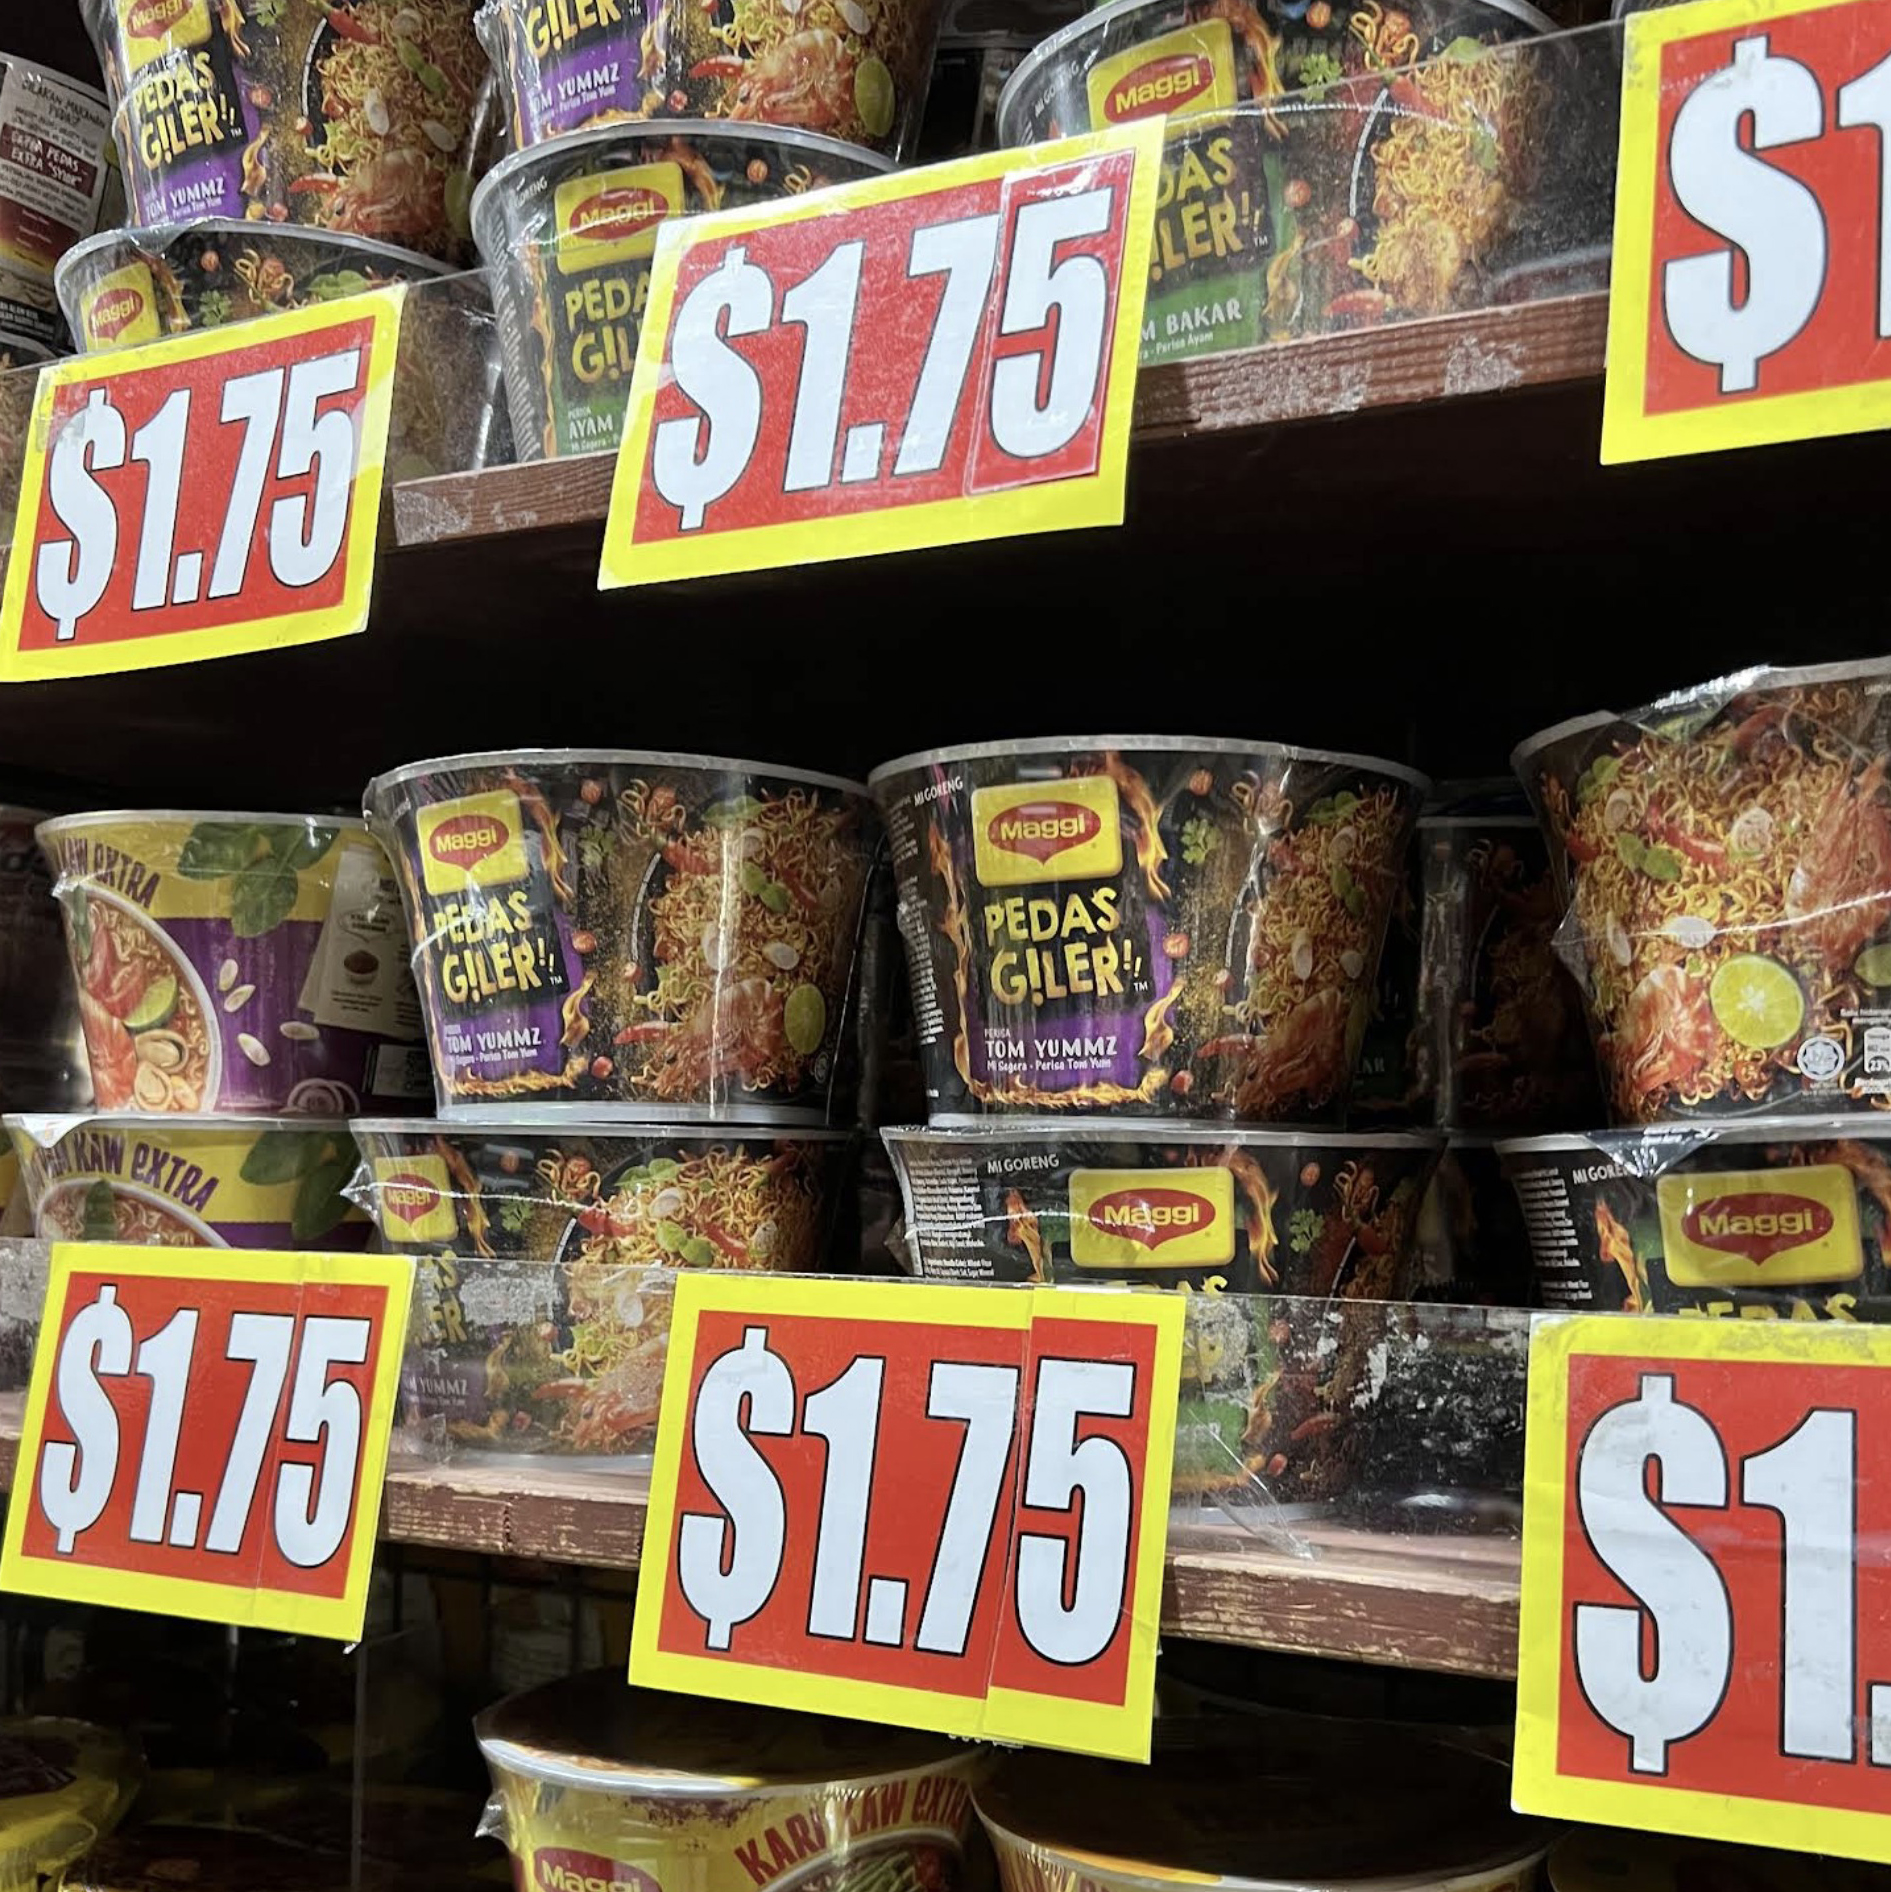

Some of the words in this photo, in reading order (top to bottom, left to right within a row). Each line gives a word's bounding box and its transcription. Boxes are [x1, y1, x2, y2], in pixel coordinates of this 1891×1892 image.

[132, 52, 216, 123] PEDAS
[557, 62, 620, 100] YUMMZ
[1115, 60, 1201, 115] Maggi
[1155, 137, 1238, 210] DAS
[169, 176, 226, 209] YUMMZ
[579, 197, 656, 227] Maggi
[565, 270, 652, 333] PEDA
[1166, 298, 1244, 336] BAKAR
[651, 186, 1113, 532] $1.75
[569, 413, 614, 440] AYAM
[35, 348, 361, 642] $1.75
[924, 775, 964, 804] GORENG
[435, 825, 498, 854] Maggi
[1000, 813, 1086, 842] Maggi
[433, 890, 533, 951] PEDAS
[984, 886, 1121, 947] PEDAS
[476, 1026, 542, 1052] YUMMZ
[984, 1039, 1026, 1059] TOM
[1033, 1036, 1118, 1059] YUMMZ
[1035, 1059, 1065, 1071] Perisa
[1066, 1057, 1088, 1070] Tom
[73, 1131, 127, 1176] KAW
[987, 1160, 1002, 1174] MI
[1003, 1153, 1060, 1171] GORENG
[1572, 1168, 1587, 1185] MI
[1587, 1163, 1631, 1182] GORE
[386, 1187, 431, 1206] Maggi
[1103, 1201, 1199, 1225] Maggi
[1700, 1208, 1813, 1237] Maggi
[39, 1283, 371, 1568] $1.75
[677, 1325, 1137, 1667] $1.75
[734, 1802, 827, 1886] KARI
